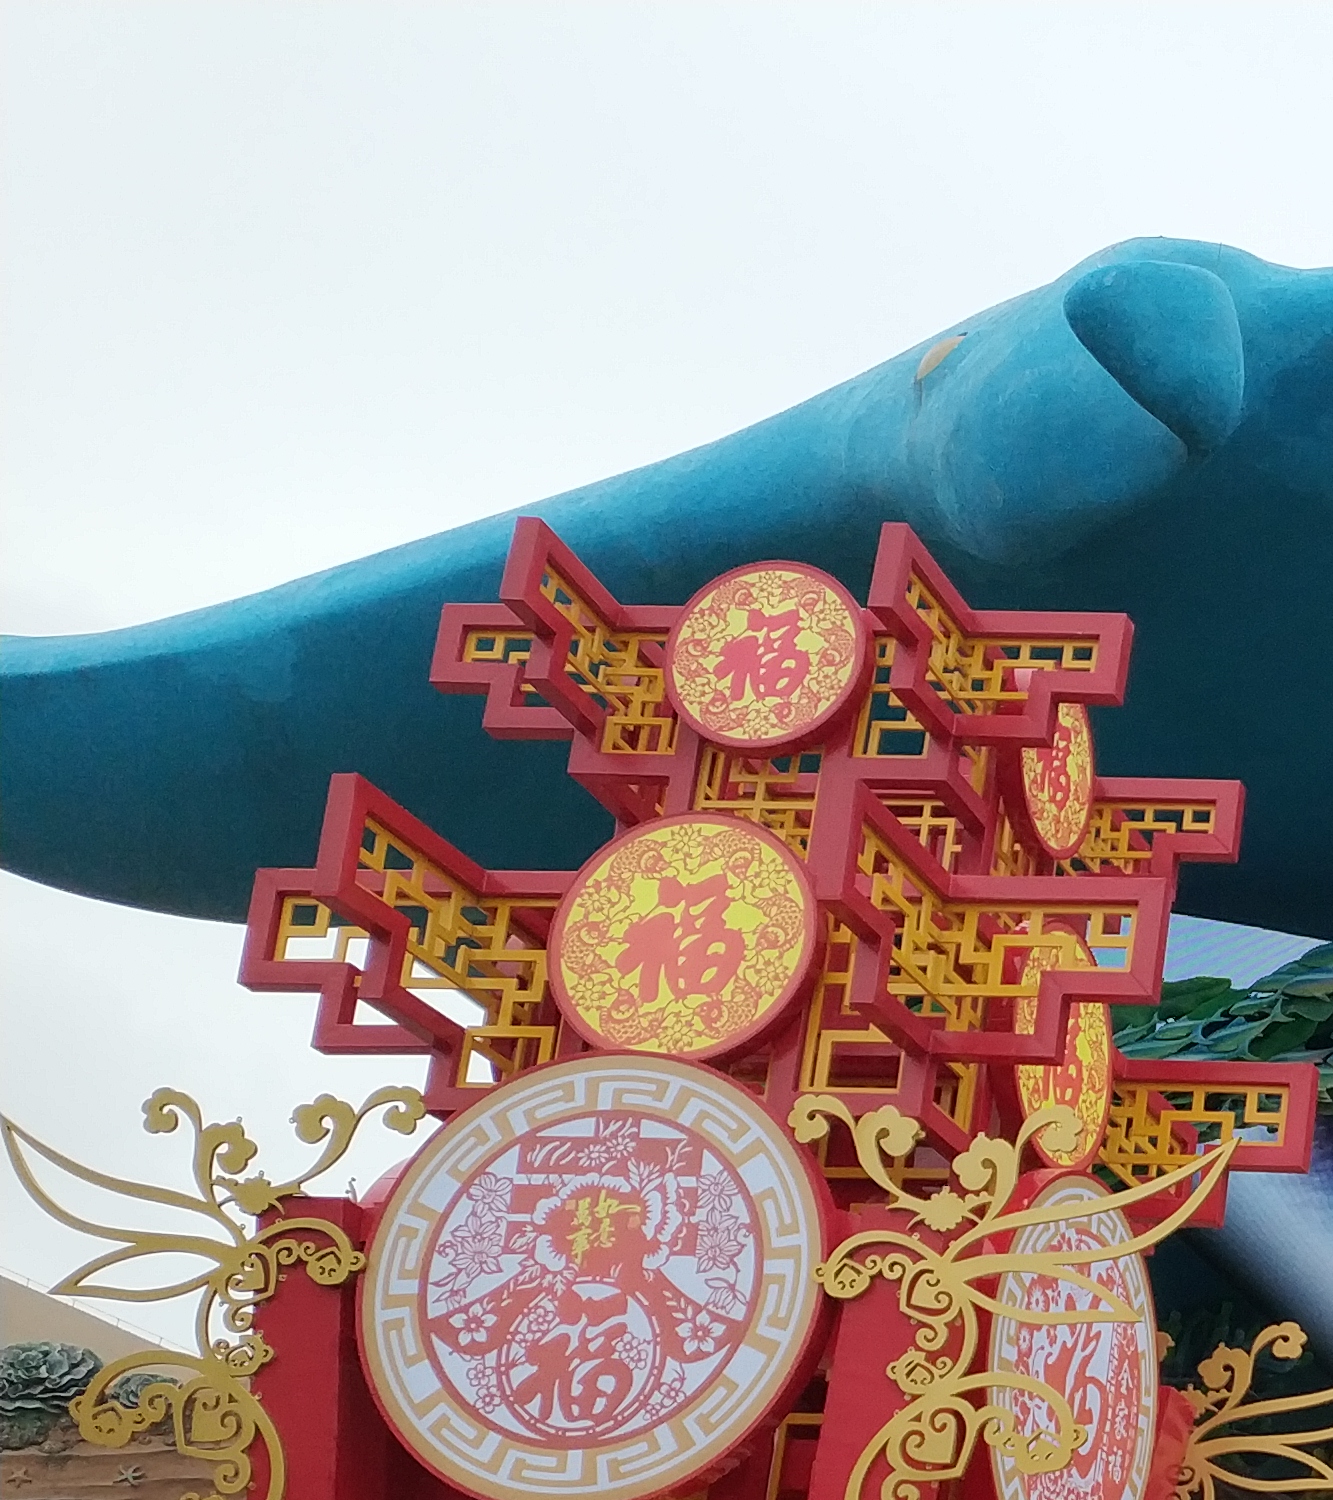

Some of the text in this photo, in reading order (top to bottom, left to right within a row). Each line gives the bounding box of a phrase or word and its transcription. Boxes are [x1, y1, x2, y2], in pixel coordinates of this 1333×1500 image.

[718, 606, 811, 702] 福
[615, 873, 746, 1002] 福
[1108, 1360, 1134, 1484] 全家福
